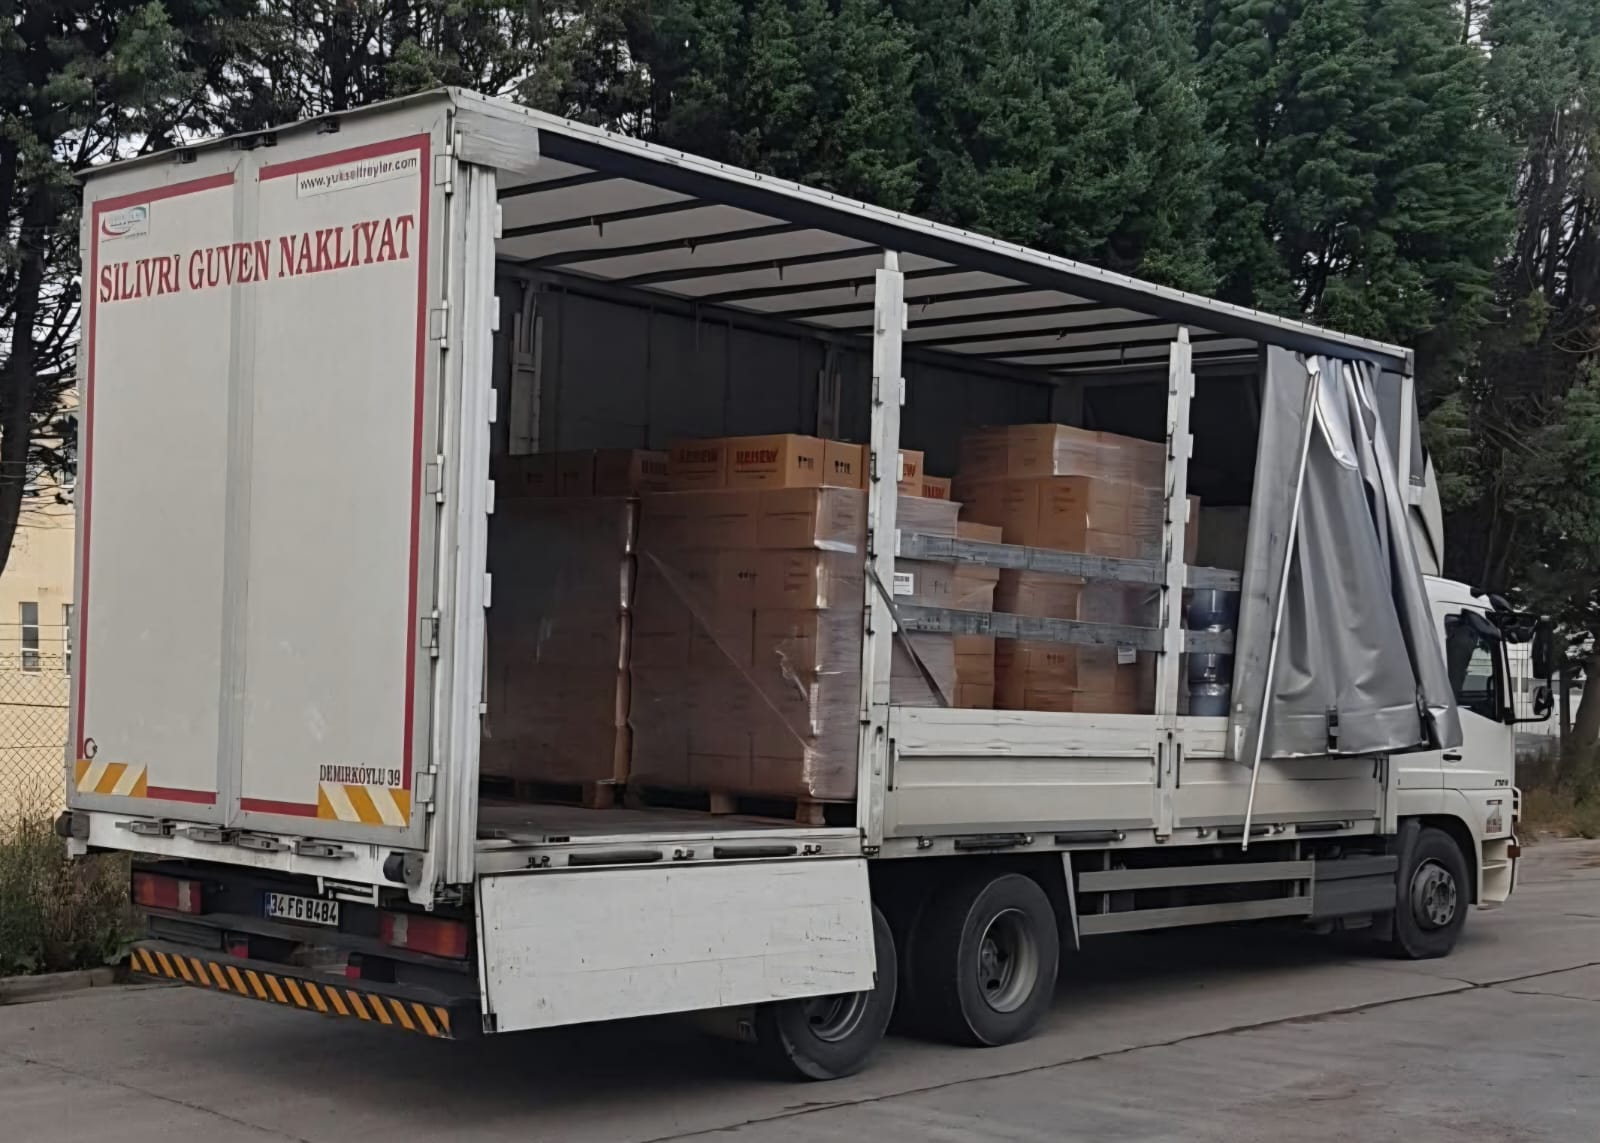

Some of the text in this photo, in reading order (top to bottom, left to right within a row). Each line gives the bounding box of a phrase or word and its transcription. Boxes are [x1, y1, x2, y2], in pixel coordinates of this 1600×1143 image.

[387, 769, 401, 786] 39
[270, 894, 337, 923] 34 FG 8484
